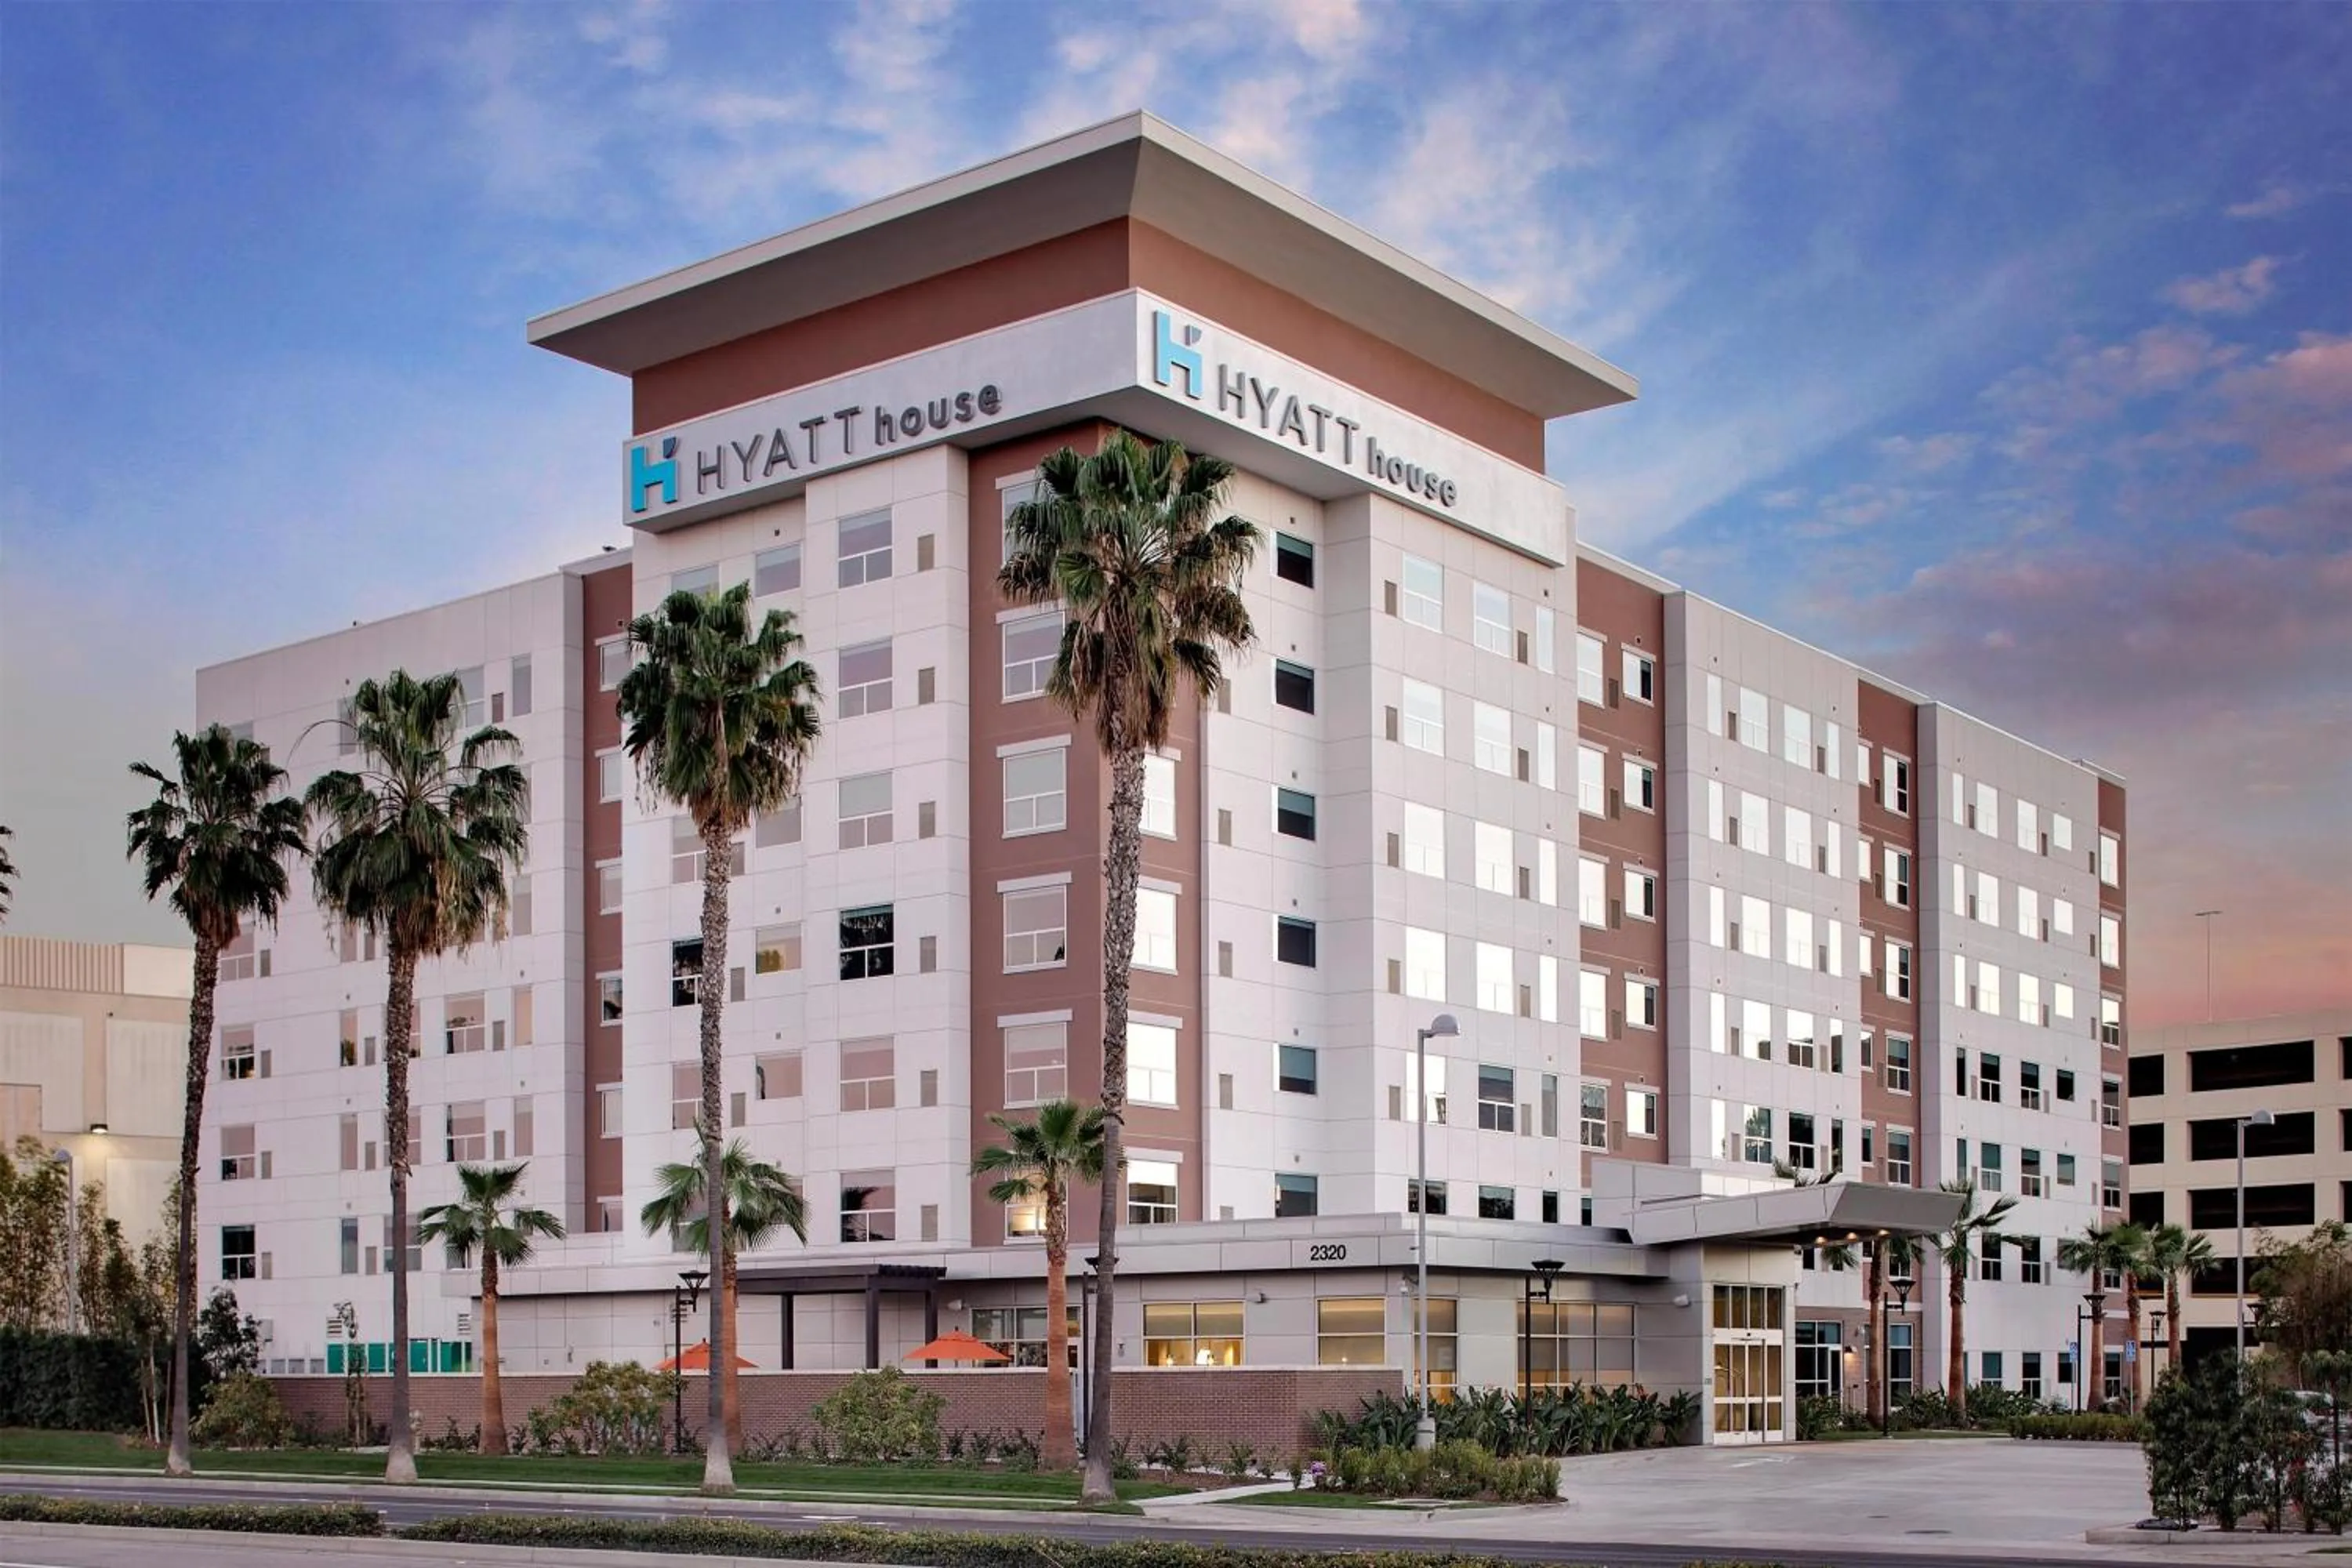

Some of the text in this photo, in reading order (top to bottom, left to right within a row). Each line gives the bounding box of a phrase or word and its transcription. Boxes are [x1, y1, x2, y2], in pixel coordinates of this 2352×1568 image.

[697, 405, 862, 494] HYATT
[874, 383, 1002, 446] house
[1218, 363, 1360, 464] HYATT
[1367, 436, 1457, 506] house
[1310, 1244, 1346, 1261] 2320
